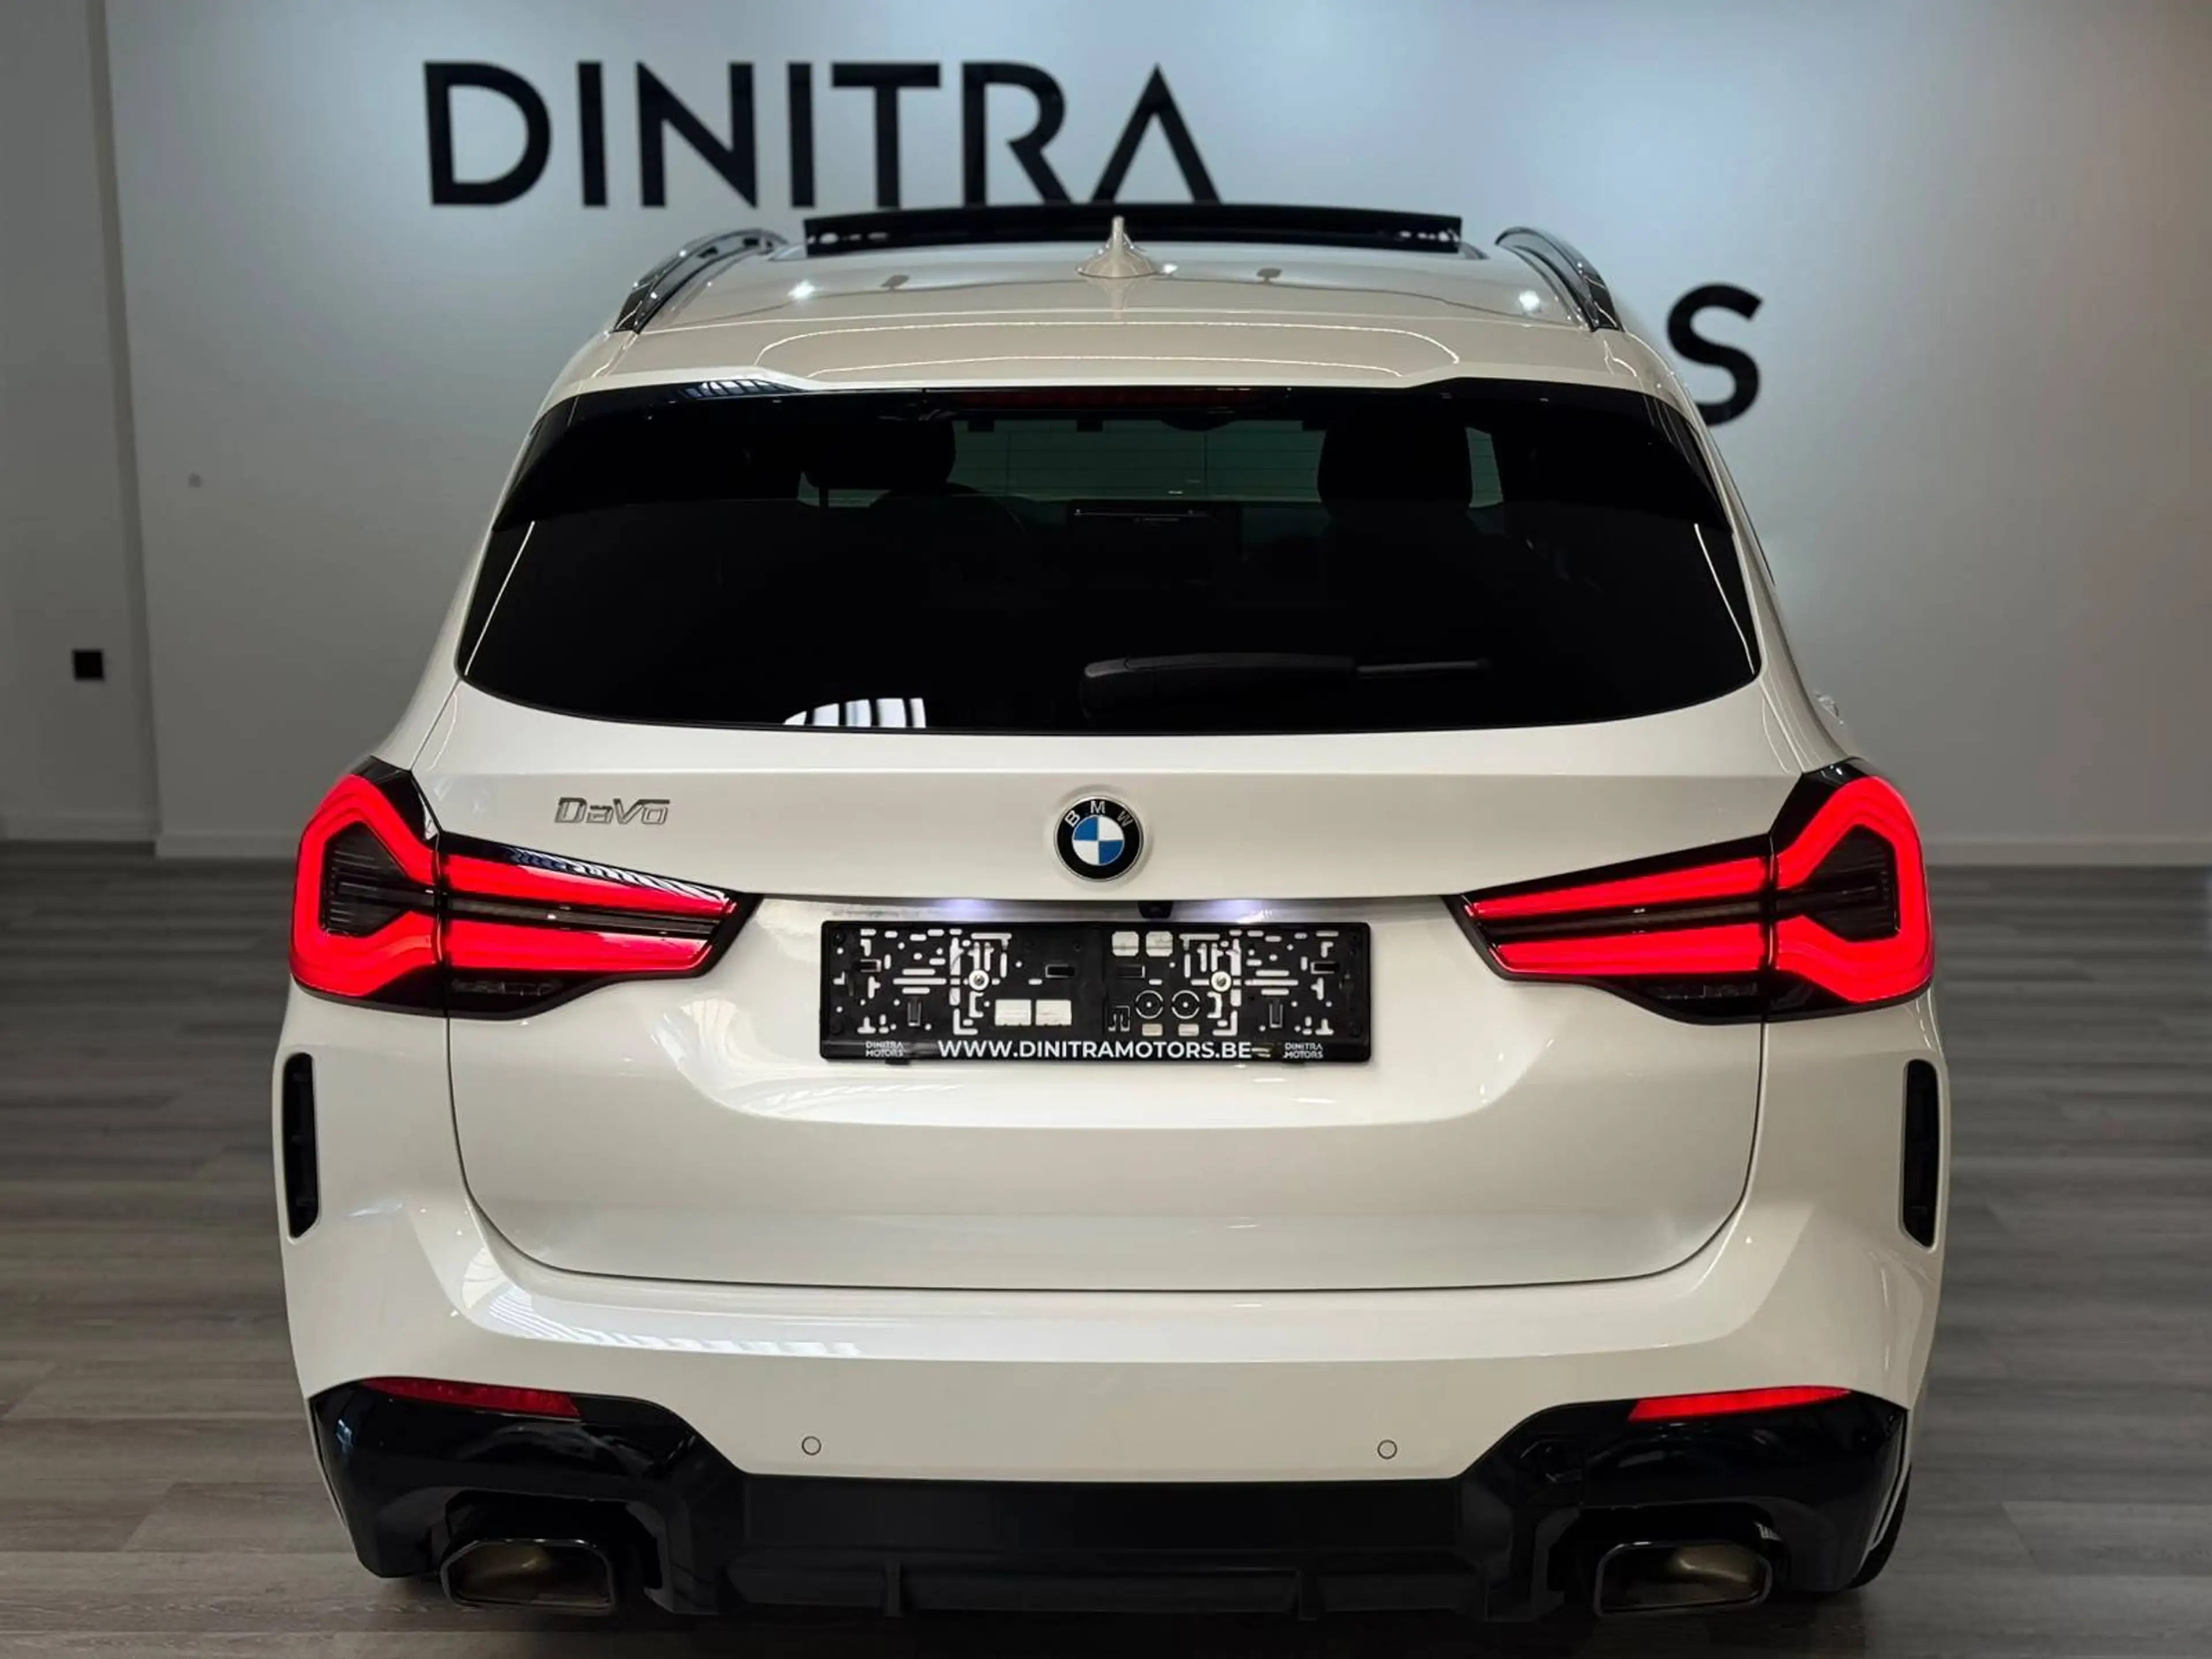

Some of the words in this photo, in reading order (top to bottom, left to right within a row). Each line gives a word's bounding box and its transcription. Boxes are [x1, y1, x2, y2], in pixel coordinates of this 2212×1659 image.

[425, 61, 1224, 209] DINITRA
[1065, 800, 1134, 828] BMW
[937, 1040, 1252, 1059] WWW.DINITRAMOTORS.BE
[1283, 1051, 1324, 1059] MOTORS
[1285, 1042, 1323, 1050] DINITRA
